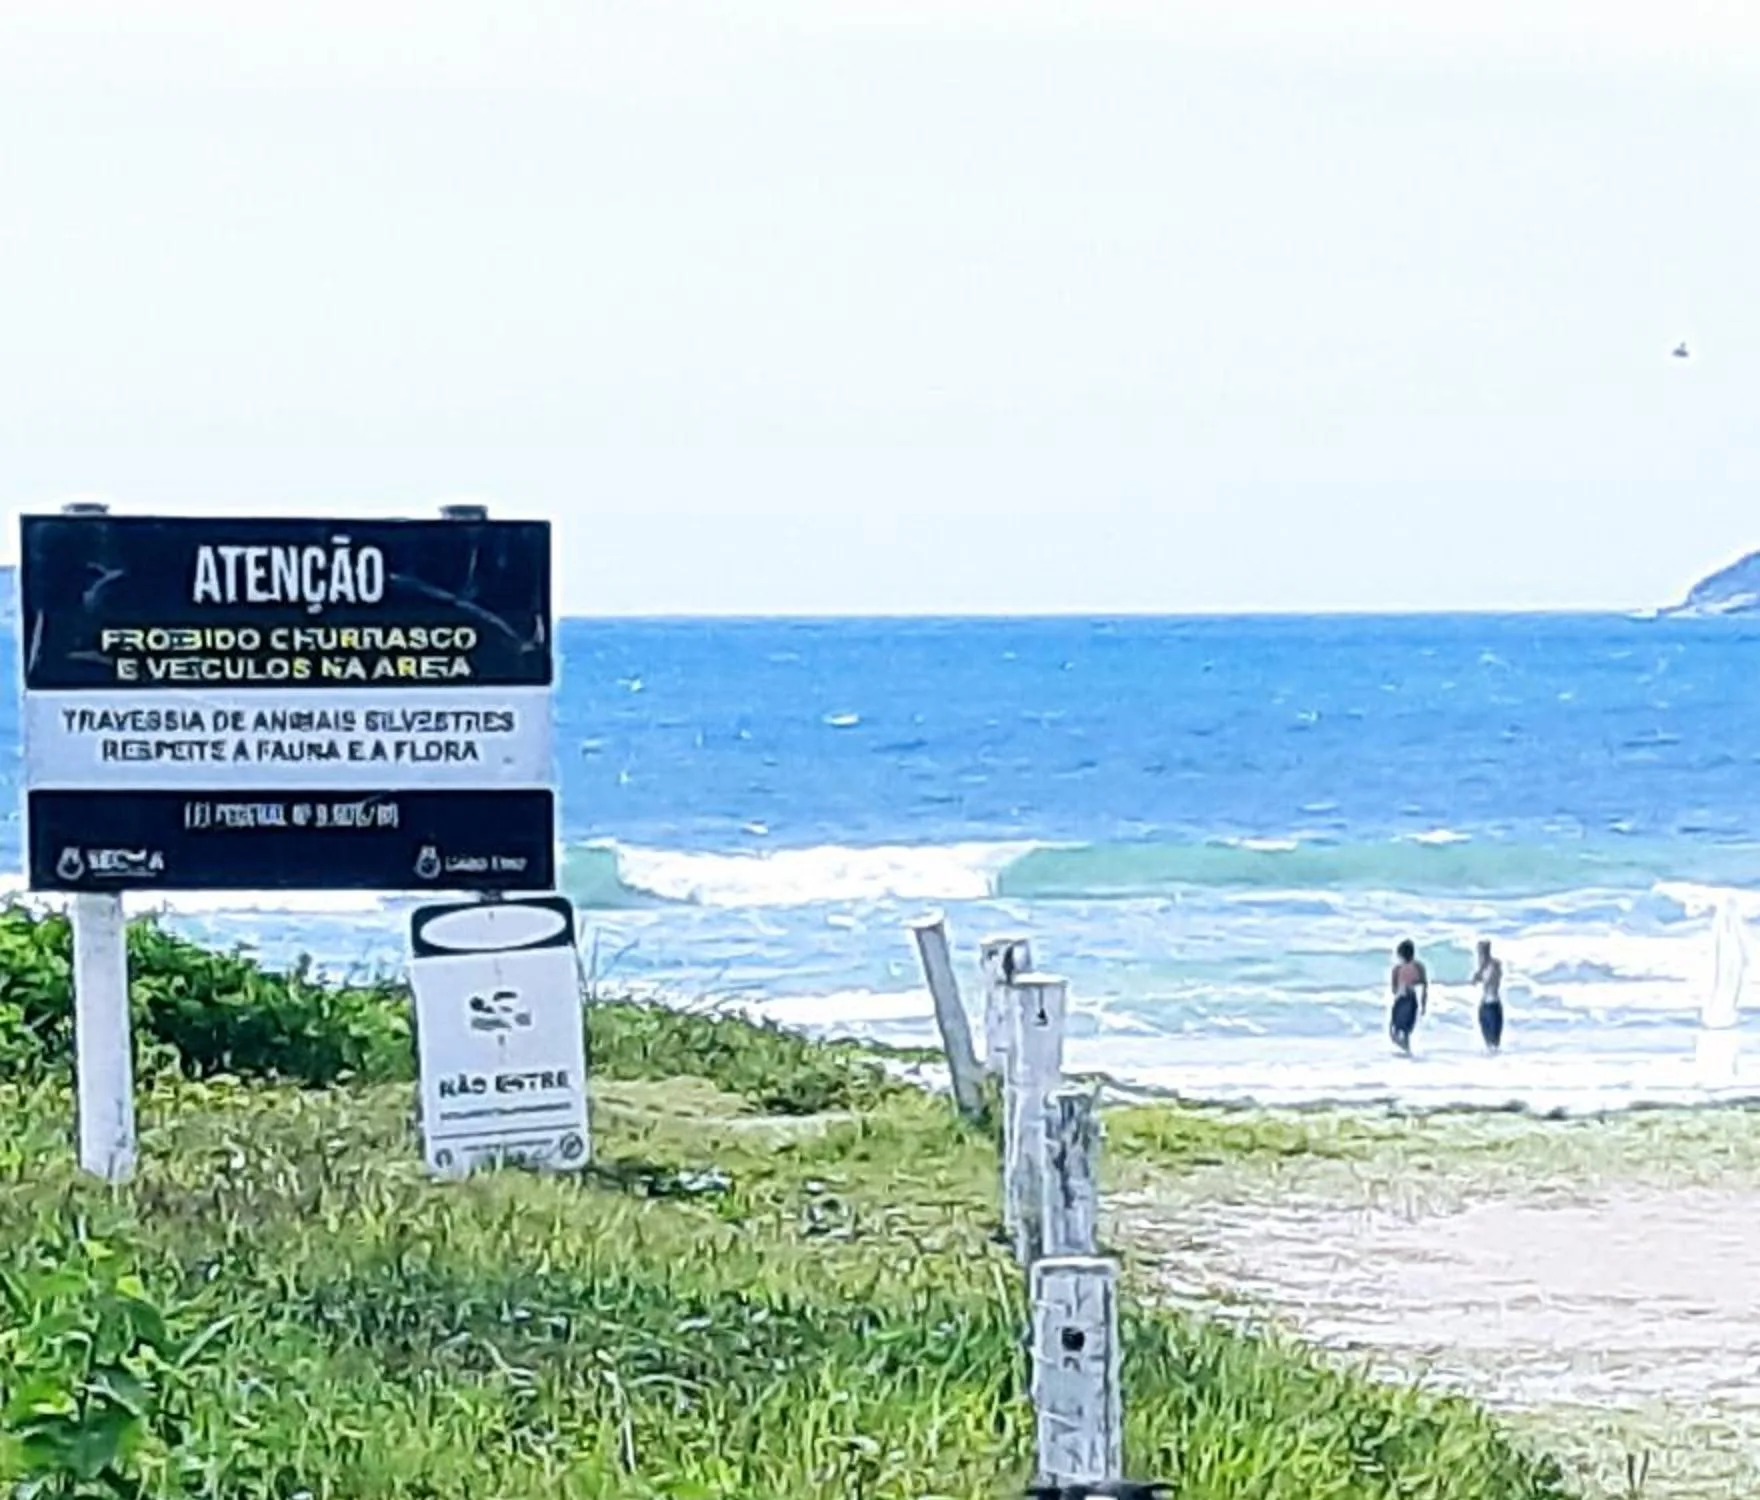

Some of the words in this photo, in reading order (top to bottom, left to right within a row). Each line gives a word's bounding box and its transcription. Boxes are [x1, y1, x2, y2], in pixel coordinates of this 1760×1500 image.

[194, 535, 384, 614] ATENÇÃO
[270, 626, 477, 650] CHURRASCO
[117, 657, 138, 679] E
[321, 656, 367, 679] NA
[62, 709, 205, 732] TRAVESSIA
[213, 709, 246, 732] DE
[253, 709, 356, 732] ANIMAIS
[365, 709, 514, 732] SILVESTRES
[103, 739, 226, 761] RESPEITE
[232, 739, 250, 761] A
[257, 739, 340, 762] FAUNA
[349, 740, 365, 761] E
[369, 740, 388, 761] A
[394, 740, 479, 762] FLORA
[440, 1072, 487, 1098] NÃO
